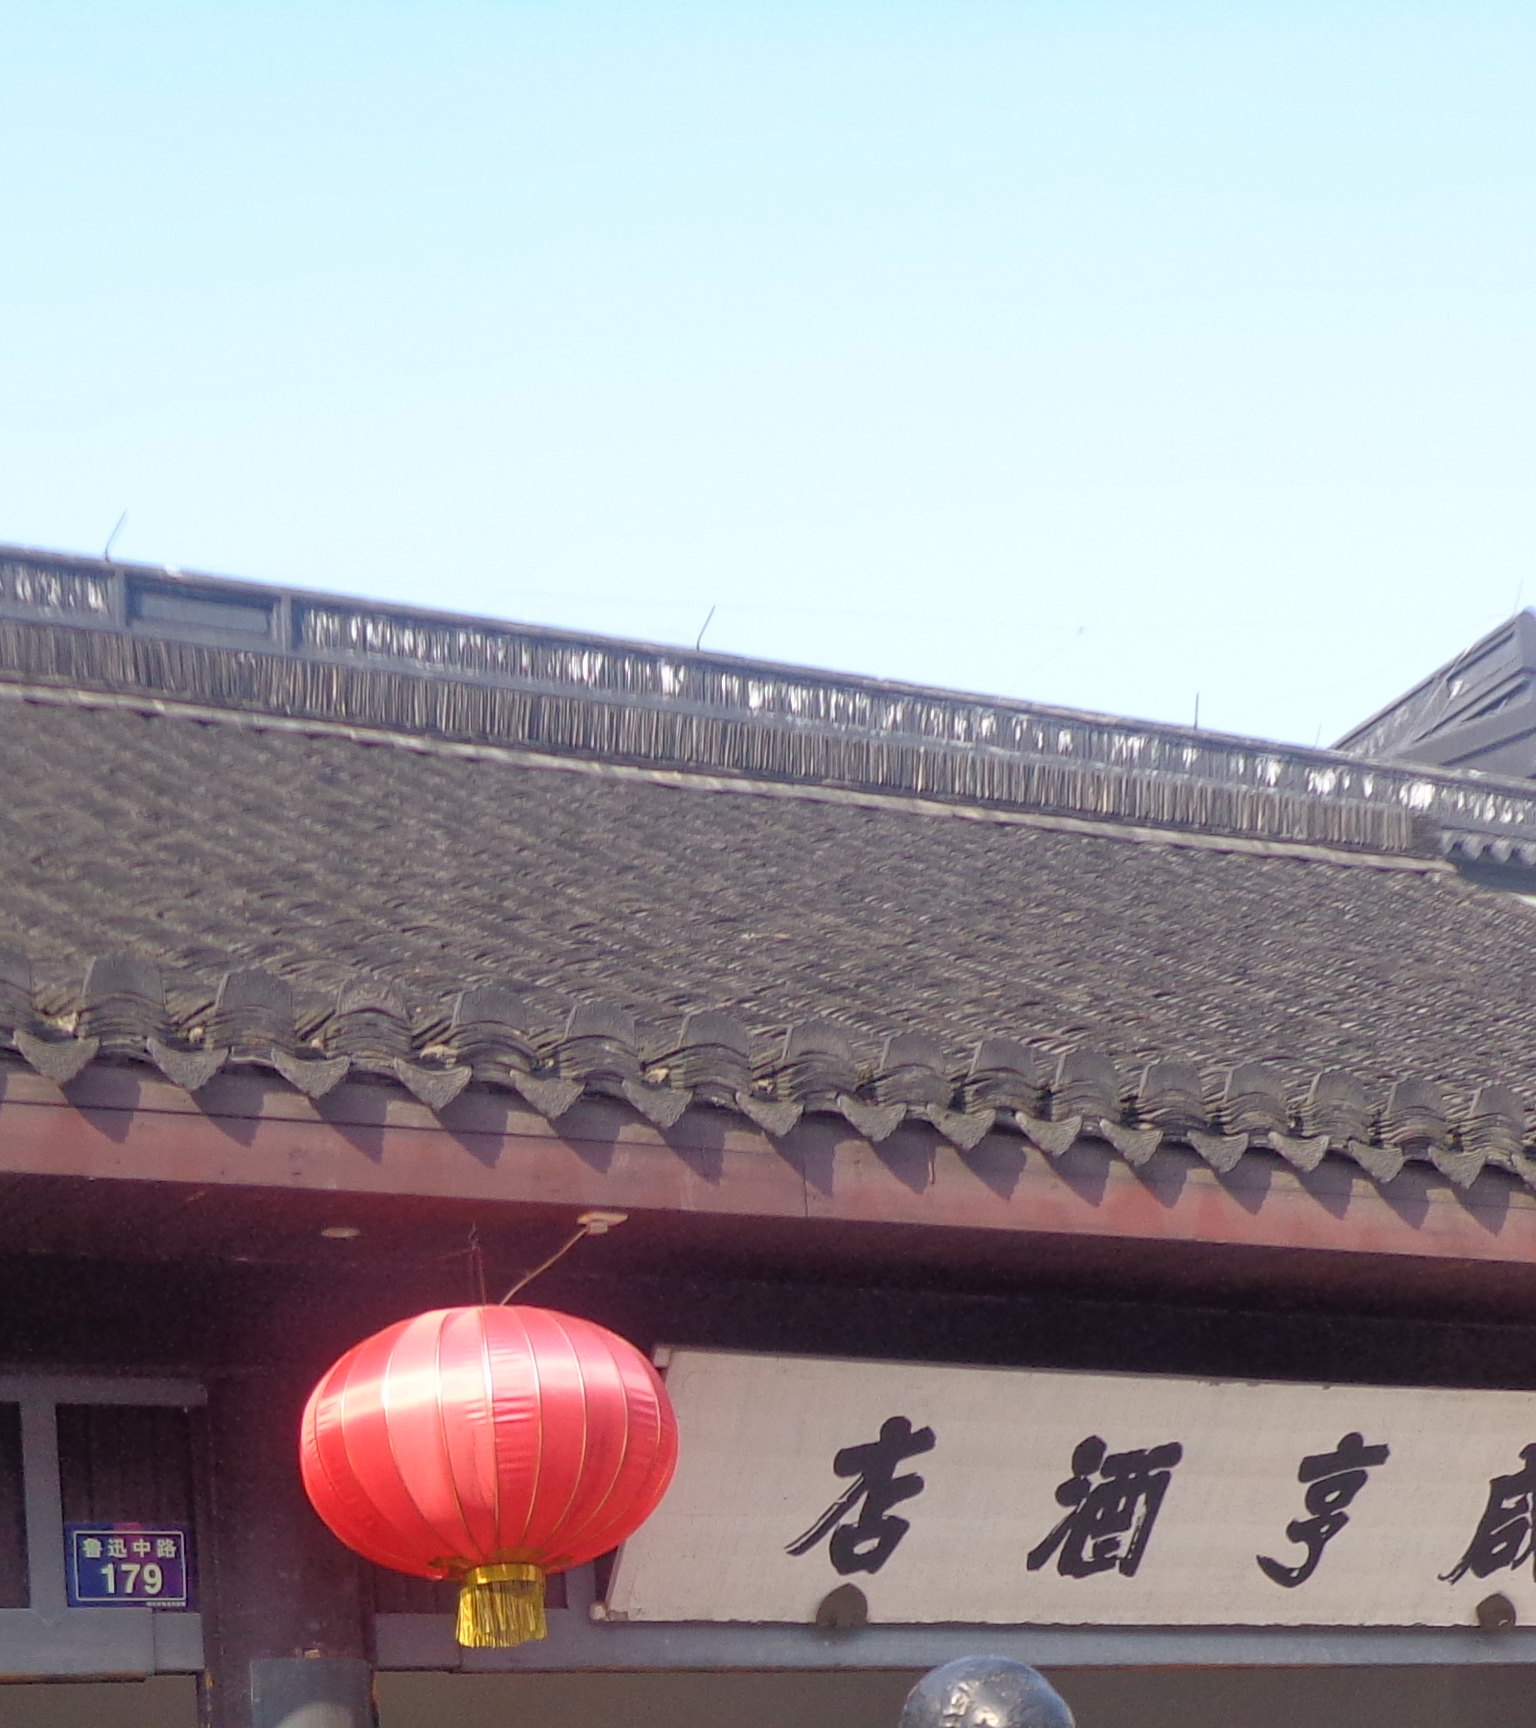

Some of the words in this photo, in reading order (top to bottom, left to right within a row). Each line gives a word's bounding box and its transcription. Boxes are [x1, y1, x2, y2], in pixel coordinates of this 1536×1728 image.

[82, 1538, 177, 1559] 鲁迅中路
[100, 1562, 163, 1594] 179
